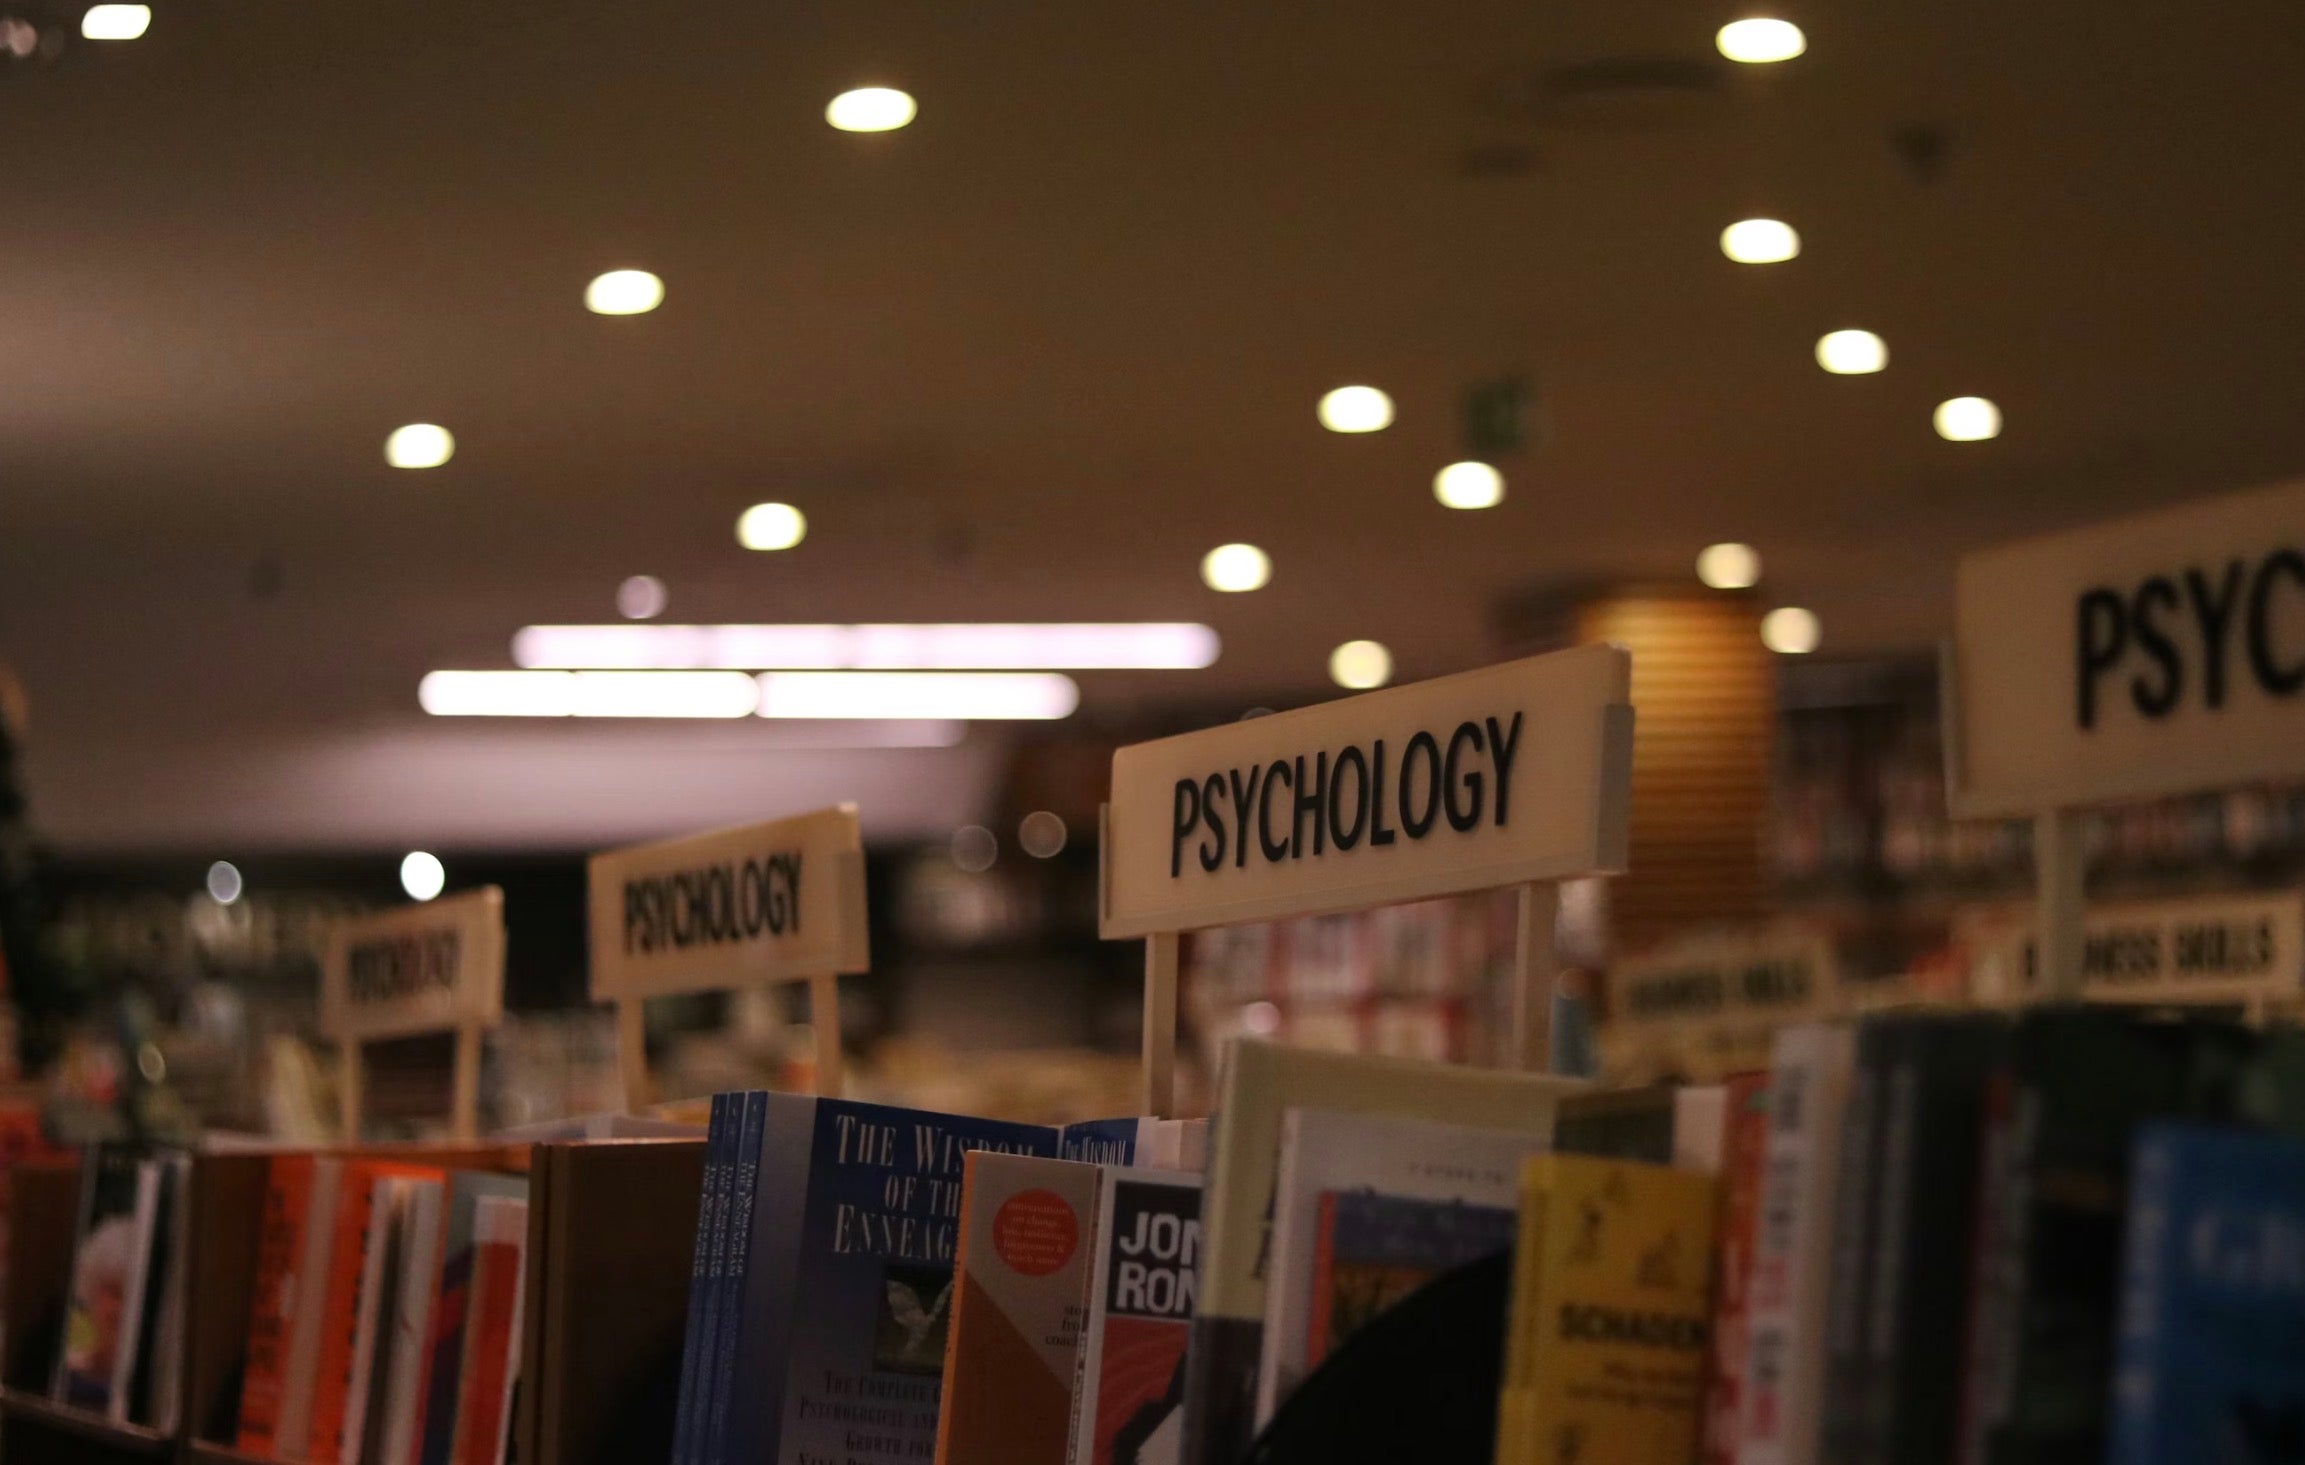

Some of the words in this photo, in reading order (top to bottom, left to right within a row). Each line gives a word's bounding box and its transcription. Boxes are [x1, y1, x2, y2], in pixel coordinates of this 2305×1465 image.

[2076, 548, 2305, 730] PSYC
[1171, 711, 1522, 878] PSYCHOLOGY
[623, 852, 801, 955] PSYCHOLOGY
[835, 1114, 897, 1168] THE
[883, 1172, 918, 1211] OF
[928, 1179, 960, 1218] TH
[834, 1202, 952, 1260] ENNEAG
[1064, 1304, 1082, 1317] sto
[1115, 1260, 1198, 1314] RON
[1559, 1302, 1708, 1350] SCHADEN
